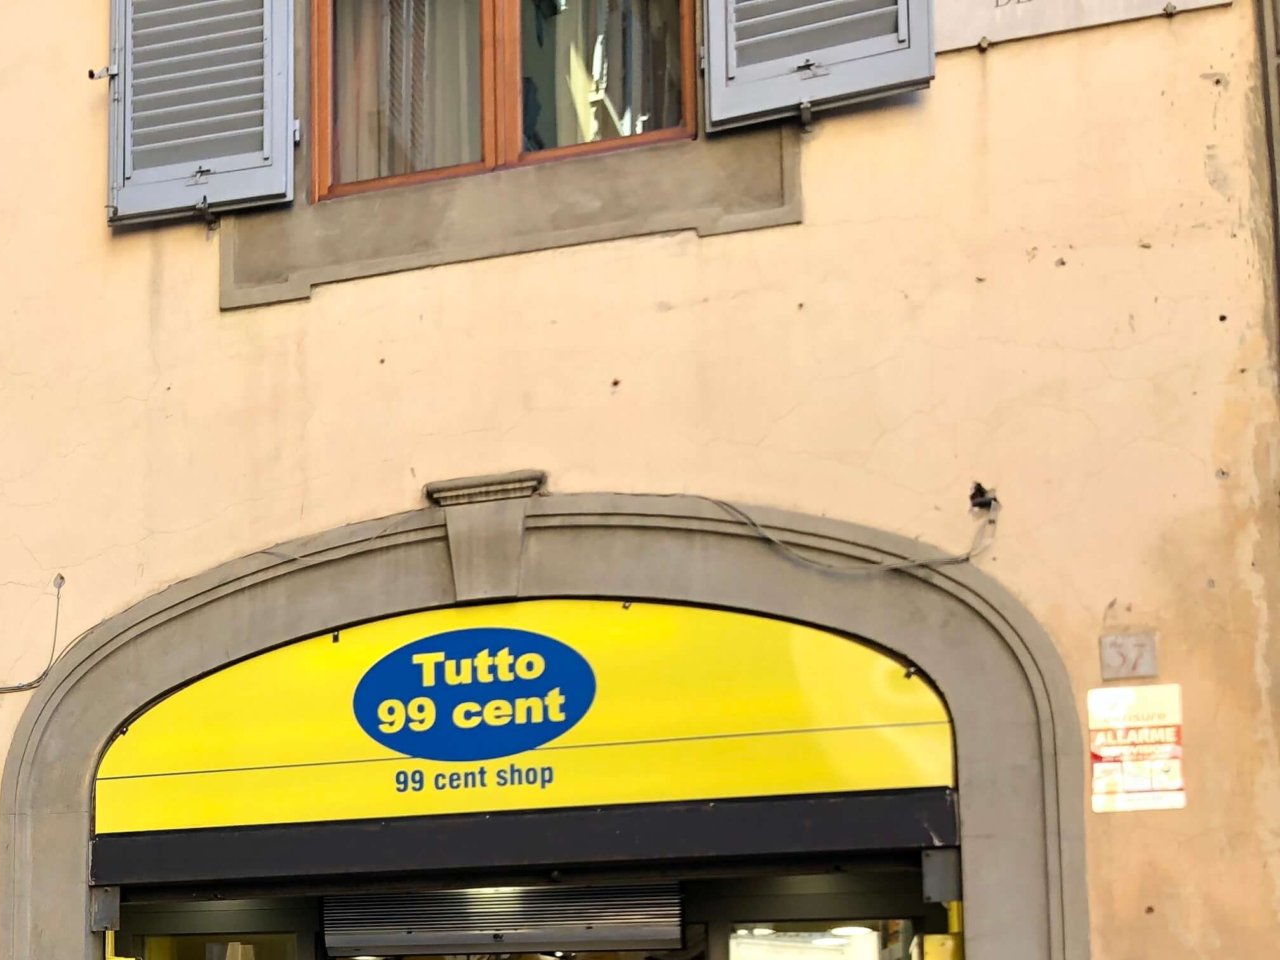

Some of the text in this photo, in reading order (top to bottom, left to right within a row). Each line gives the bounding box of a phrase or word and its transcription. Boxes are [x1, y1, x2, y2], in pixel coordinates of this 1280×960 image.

[412, 647, 546, 687] Tutto
[377, 687, 566, 734] 99 cent
[1095, 726, 1177, 747] ALLARME
[395, 764, 554, 792] 99 cent shop
